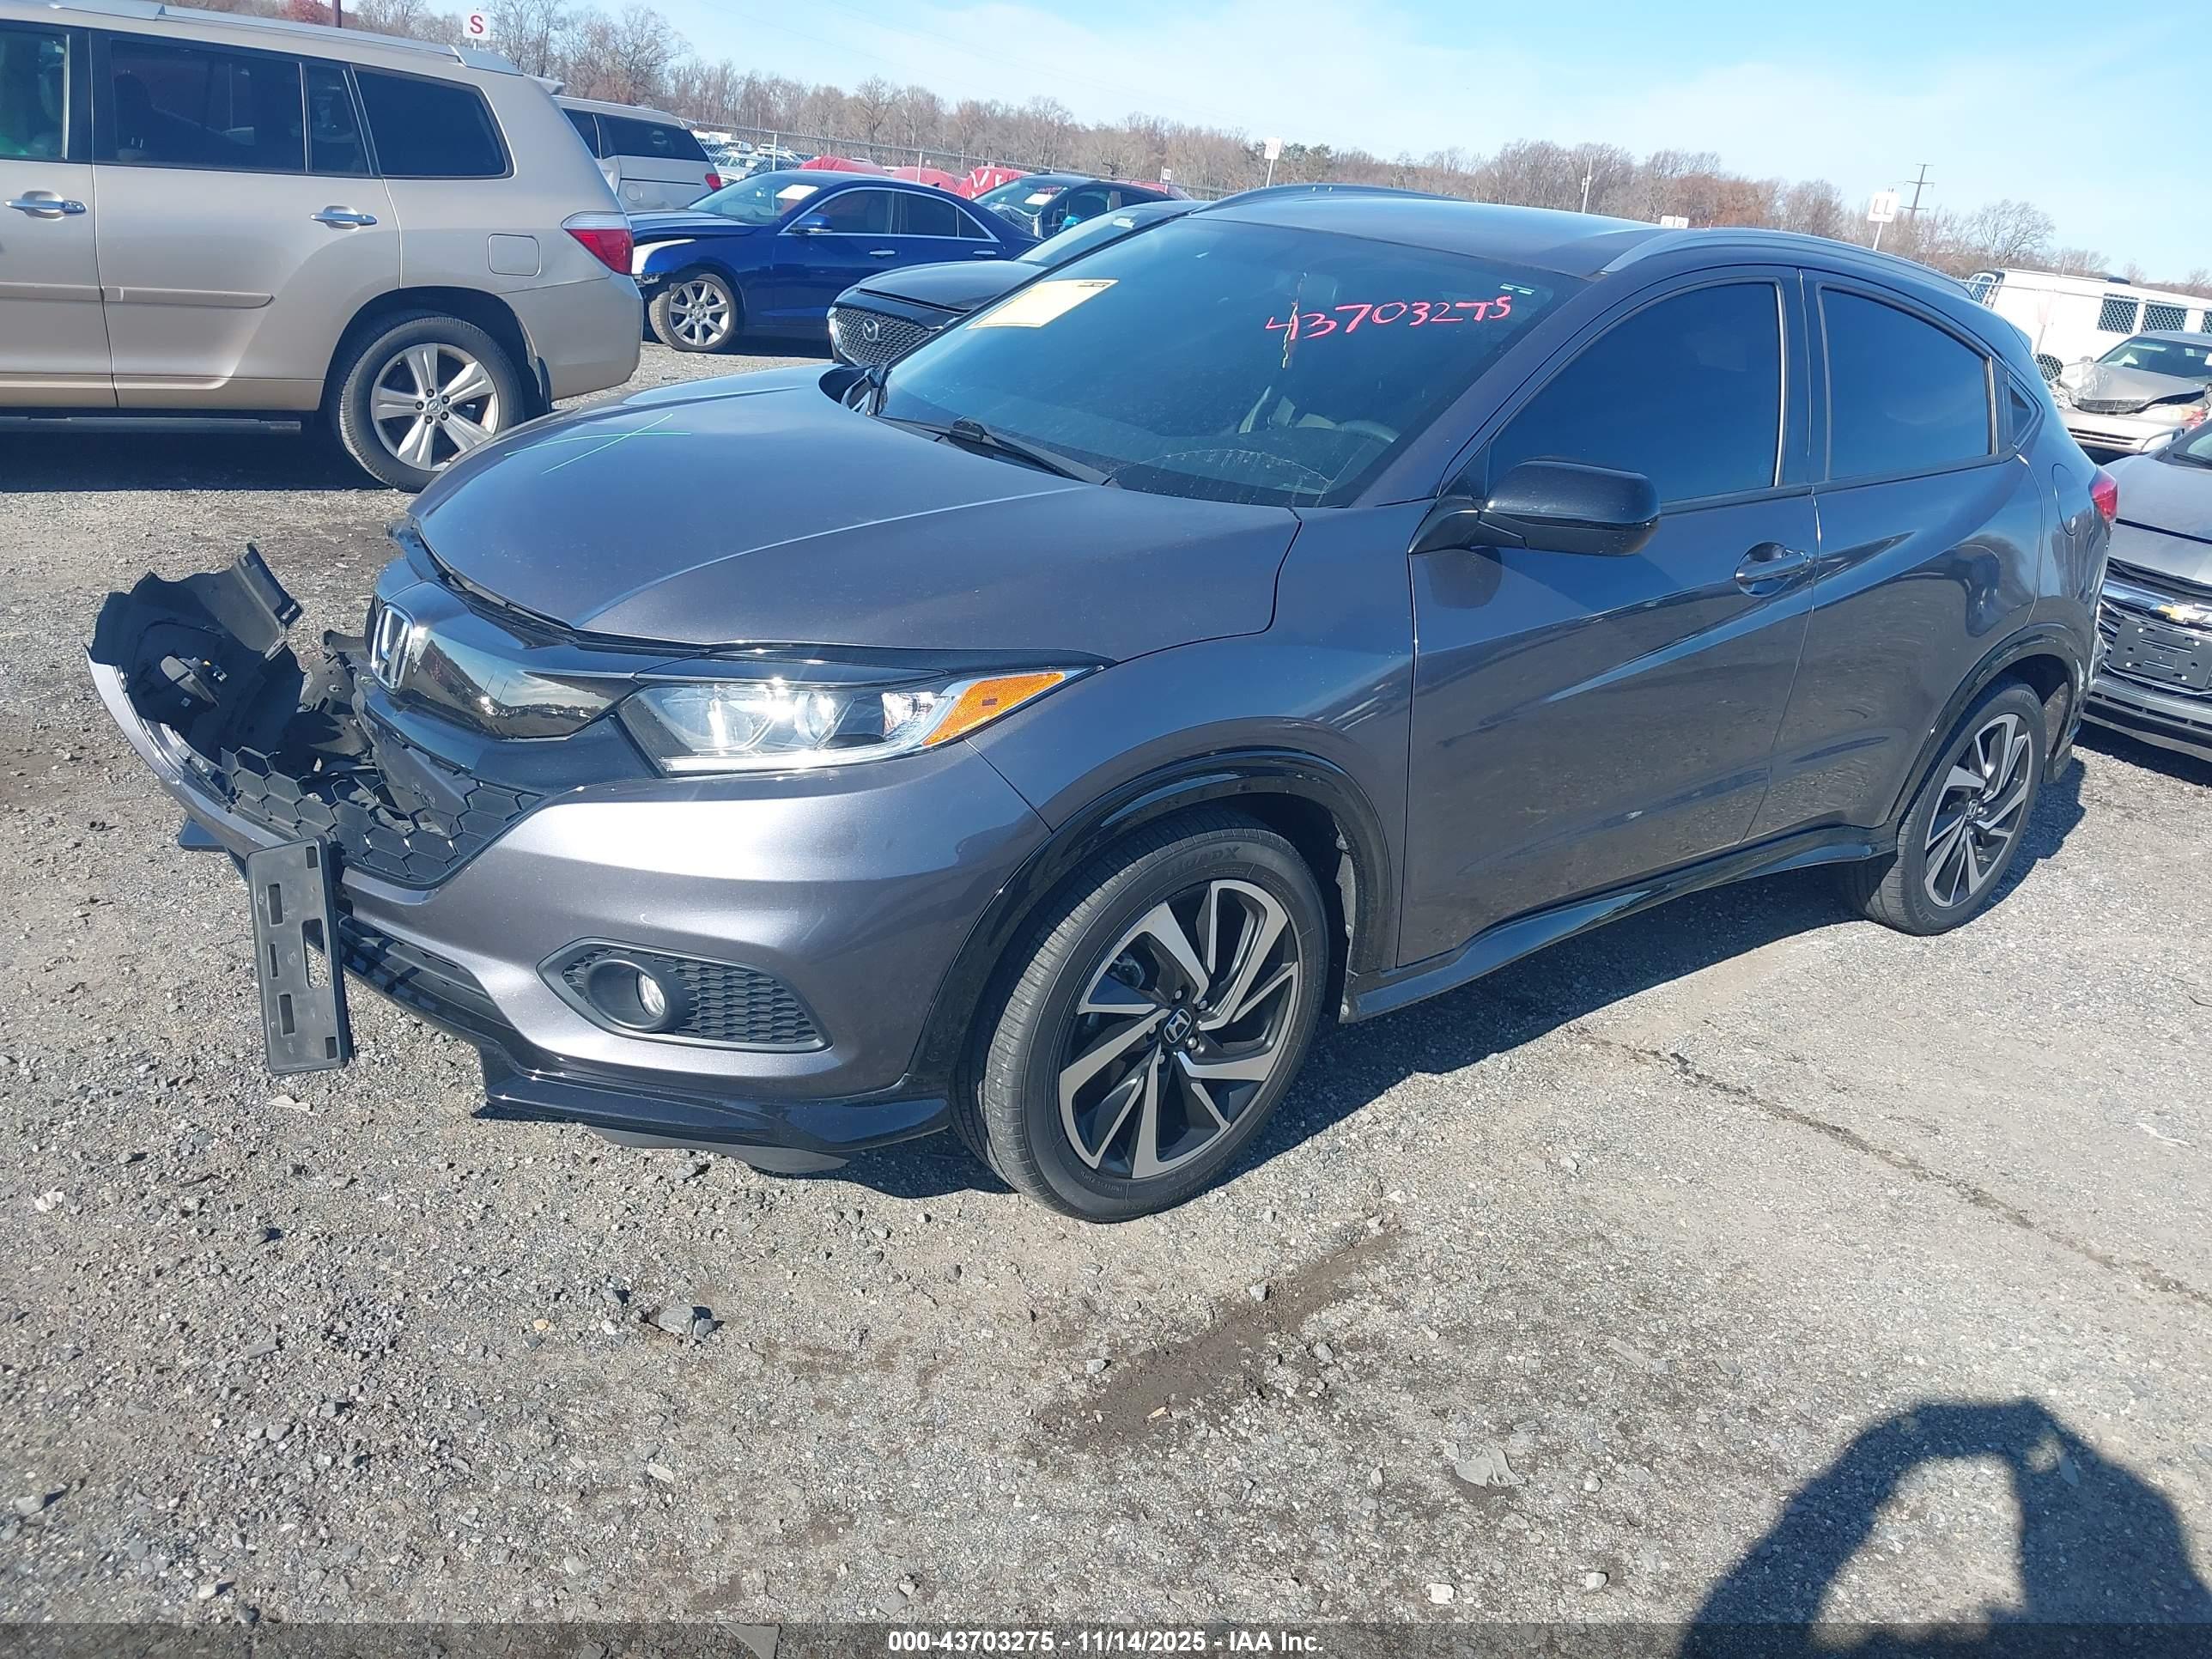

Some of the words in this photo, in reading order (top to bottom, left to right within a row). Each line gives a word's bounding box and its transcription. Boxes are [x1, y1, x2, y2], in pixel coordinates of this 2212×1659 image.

[470, 15, 484, 34] S
[1872, 198, 1892, 216] LL
[1265, 295, 1512, 341] 43703275
